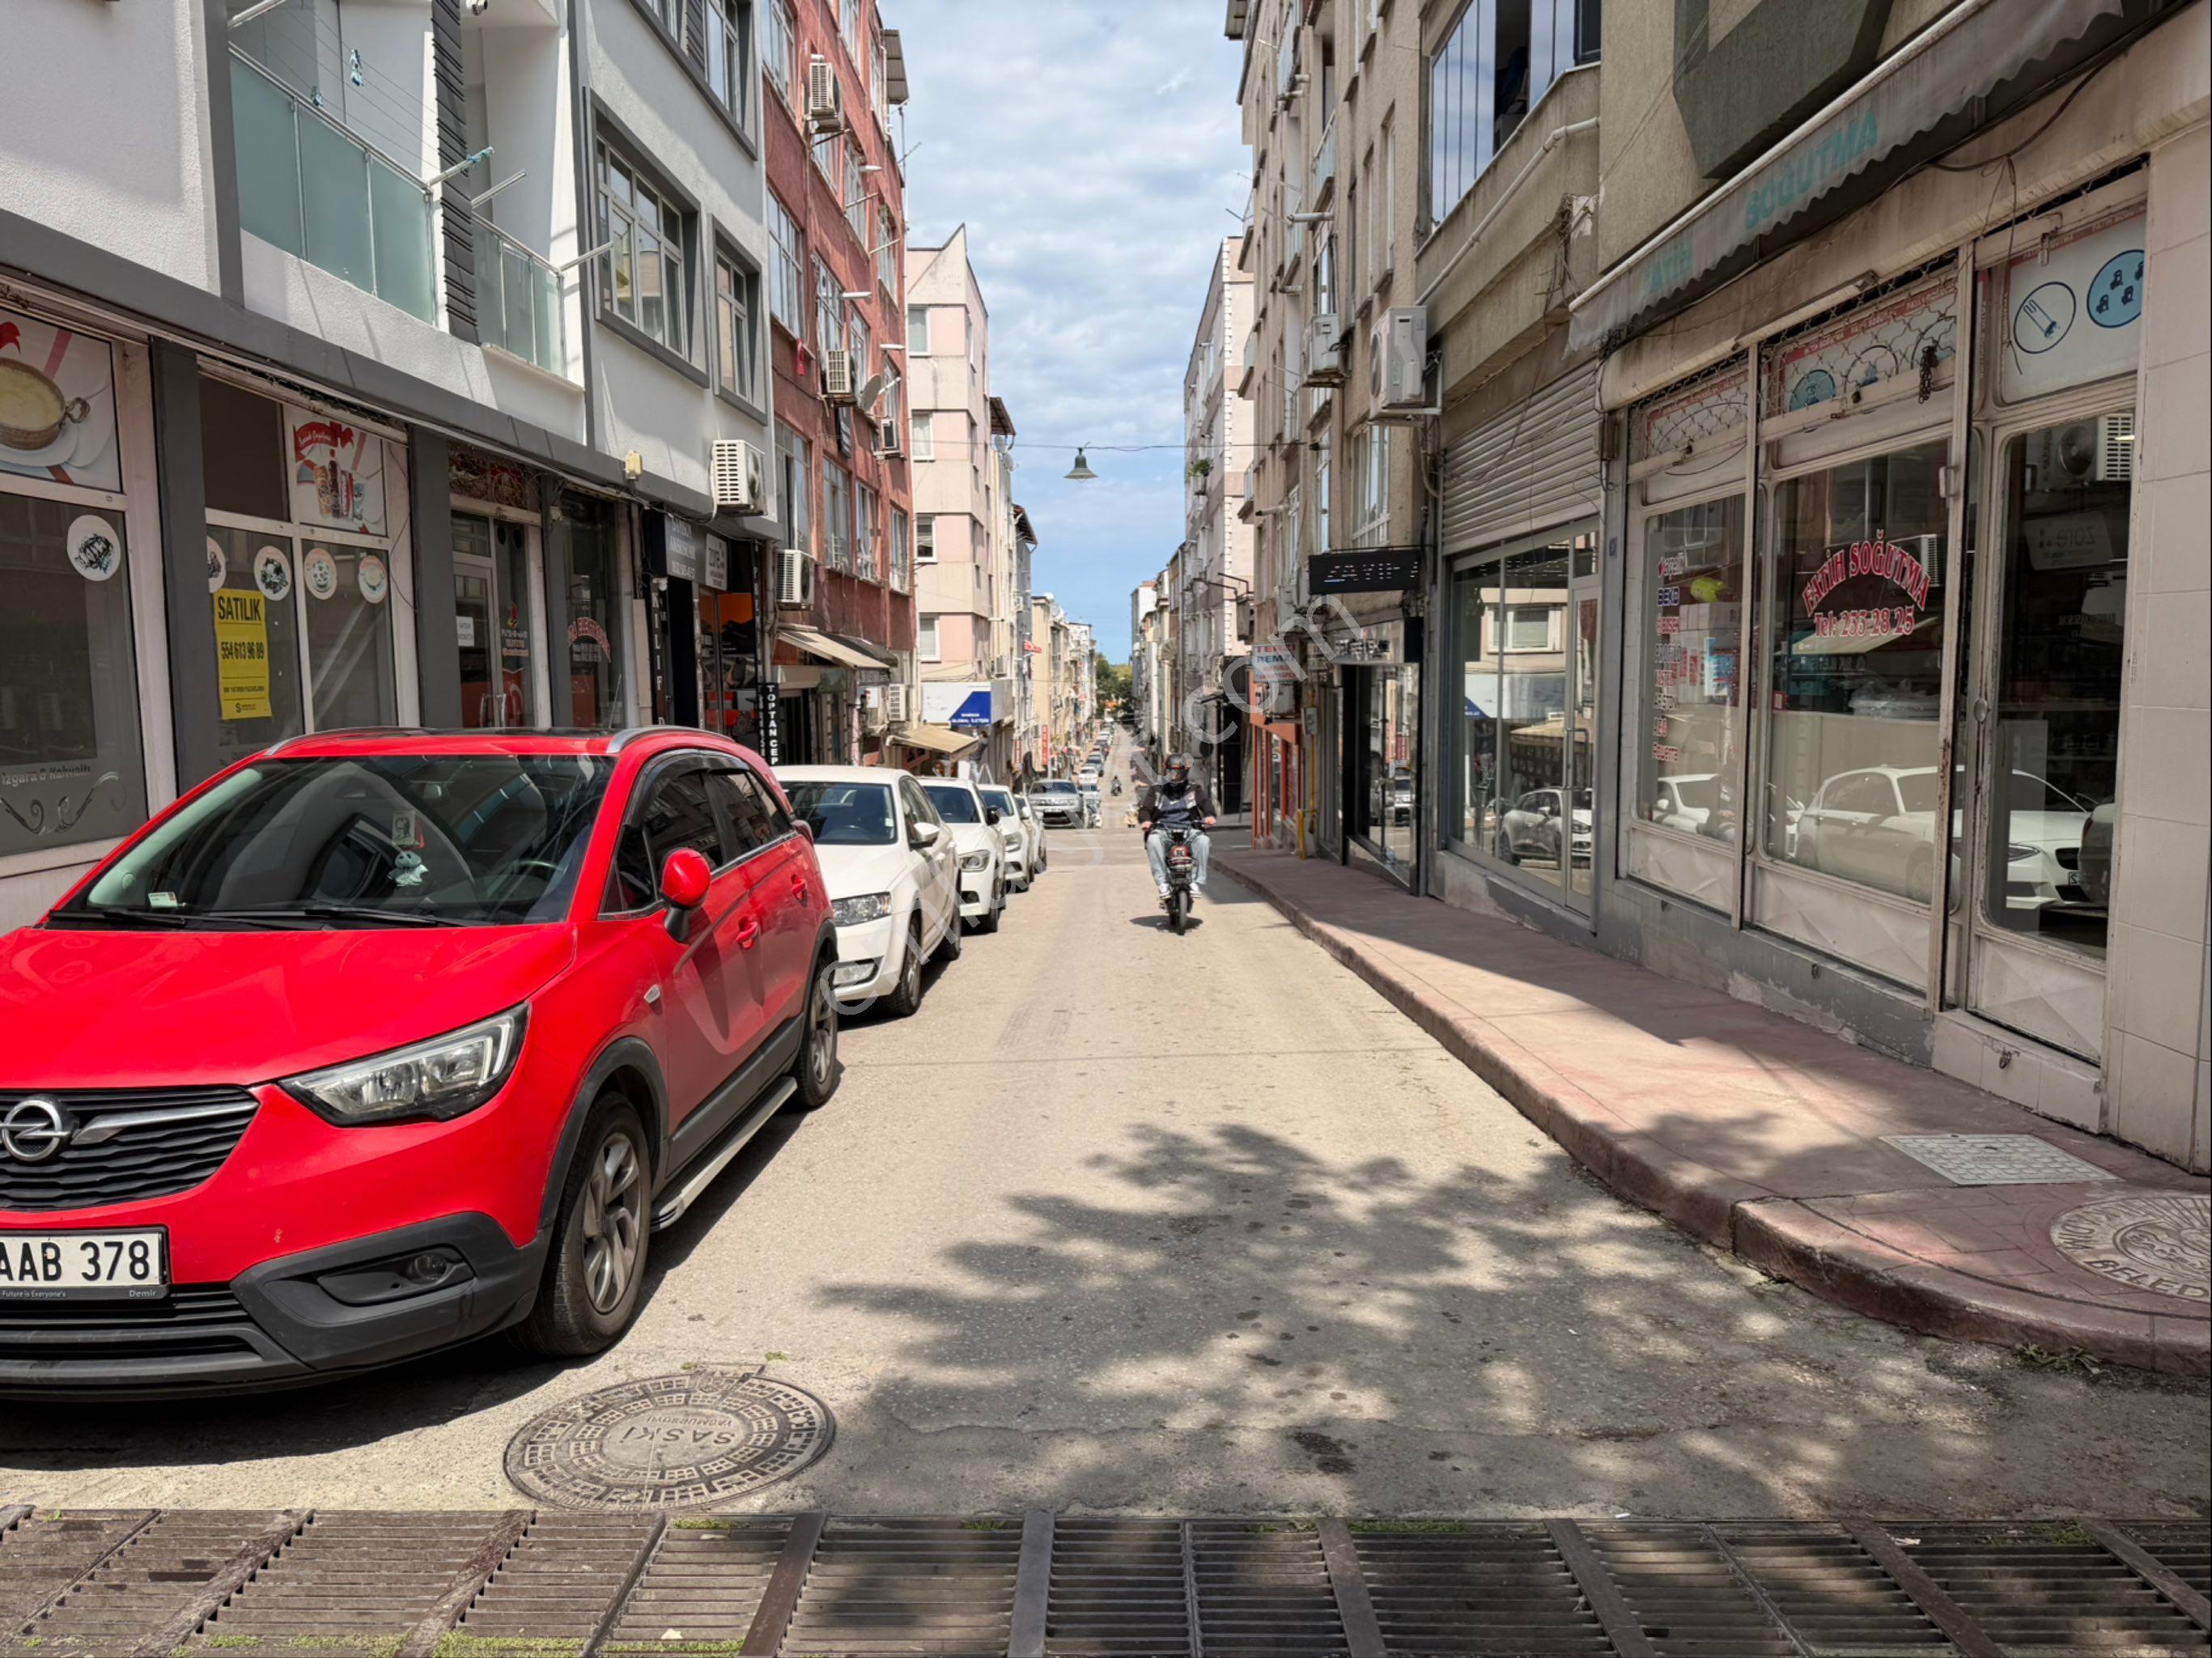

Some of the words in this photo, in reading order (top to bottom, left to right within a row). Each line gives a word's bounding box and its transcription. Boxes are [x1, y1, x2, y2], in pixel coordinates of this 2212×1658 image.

[1802, 549, 1846, 618] FATİH
[1849, 528, 1931, 612] SOĞUTMA
[218, 596, 261, 621] SATILIK
[1813, 610, 1837, 638] Tel:
[766, 685, 777, 737] TOPTAN
[769, 739, 779, 765] CEP
[0, 1241, 62, 1282] AAB
[79, 1240, 150, 1282] 378
[129, 1289, 156, 1298] Demir
[618, 1426, 736, 1445] SASKİ
